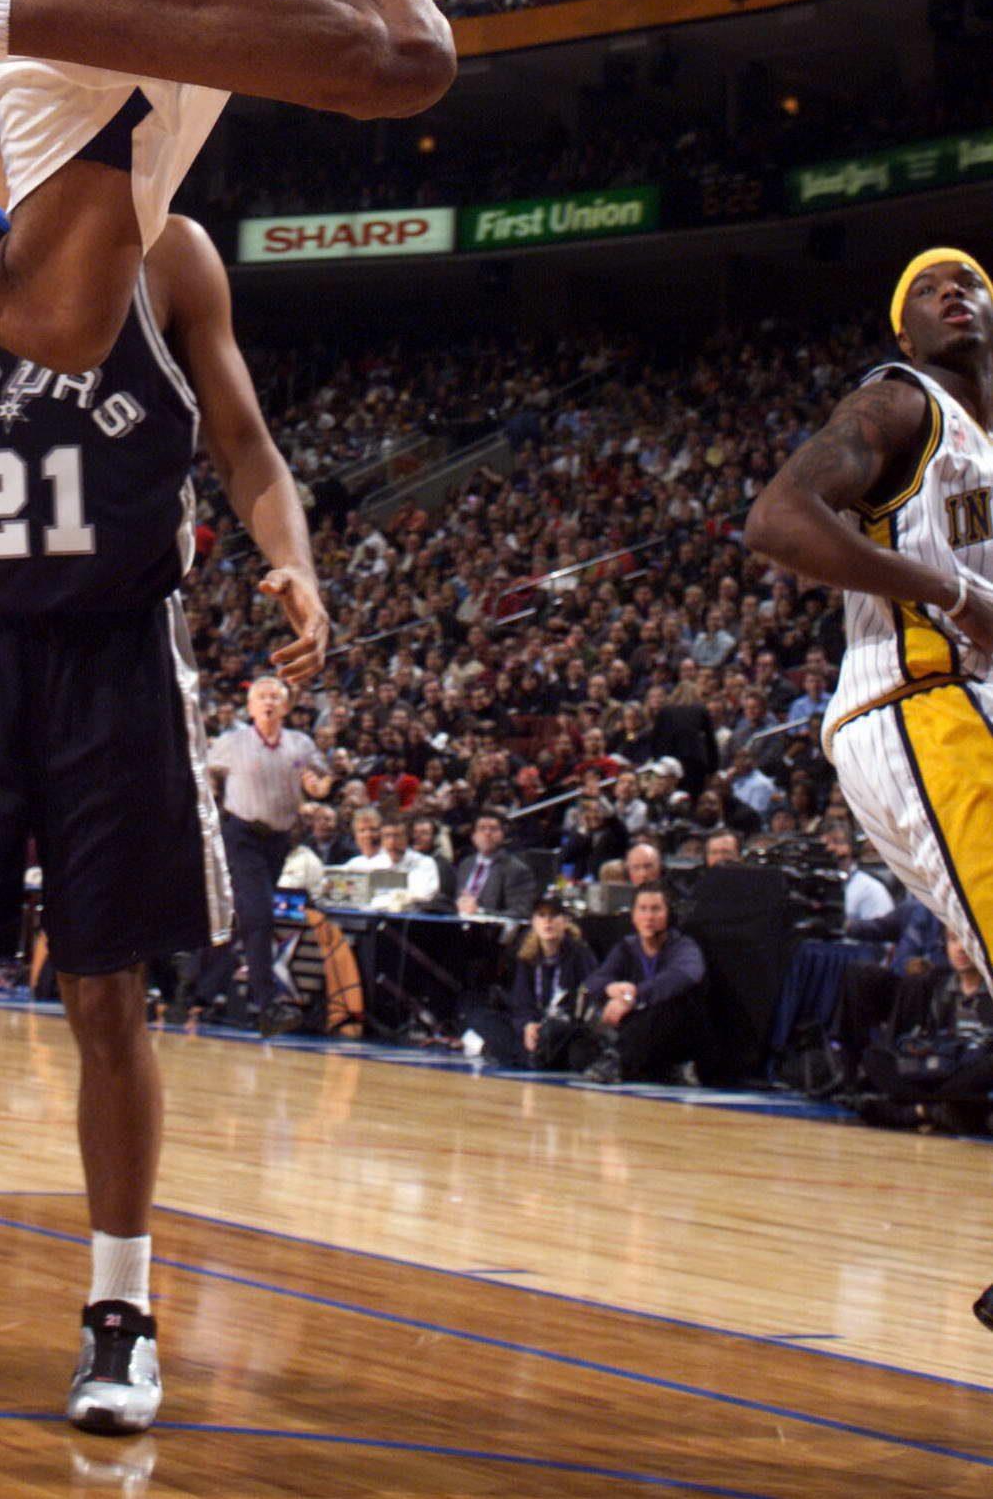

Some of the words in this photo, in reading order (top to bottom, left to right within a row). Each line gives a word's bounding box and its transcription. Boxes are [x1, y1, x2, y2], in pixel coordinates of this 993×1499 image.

[263, 217, 429, 254] SHARP
[474, 205, 543, 243] First
[548, 197, 644, 233] Union
